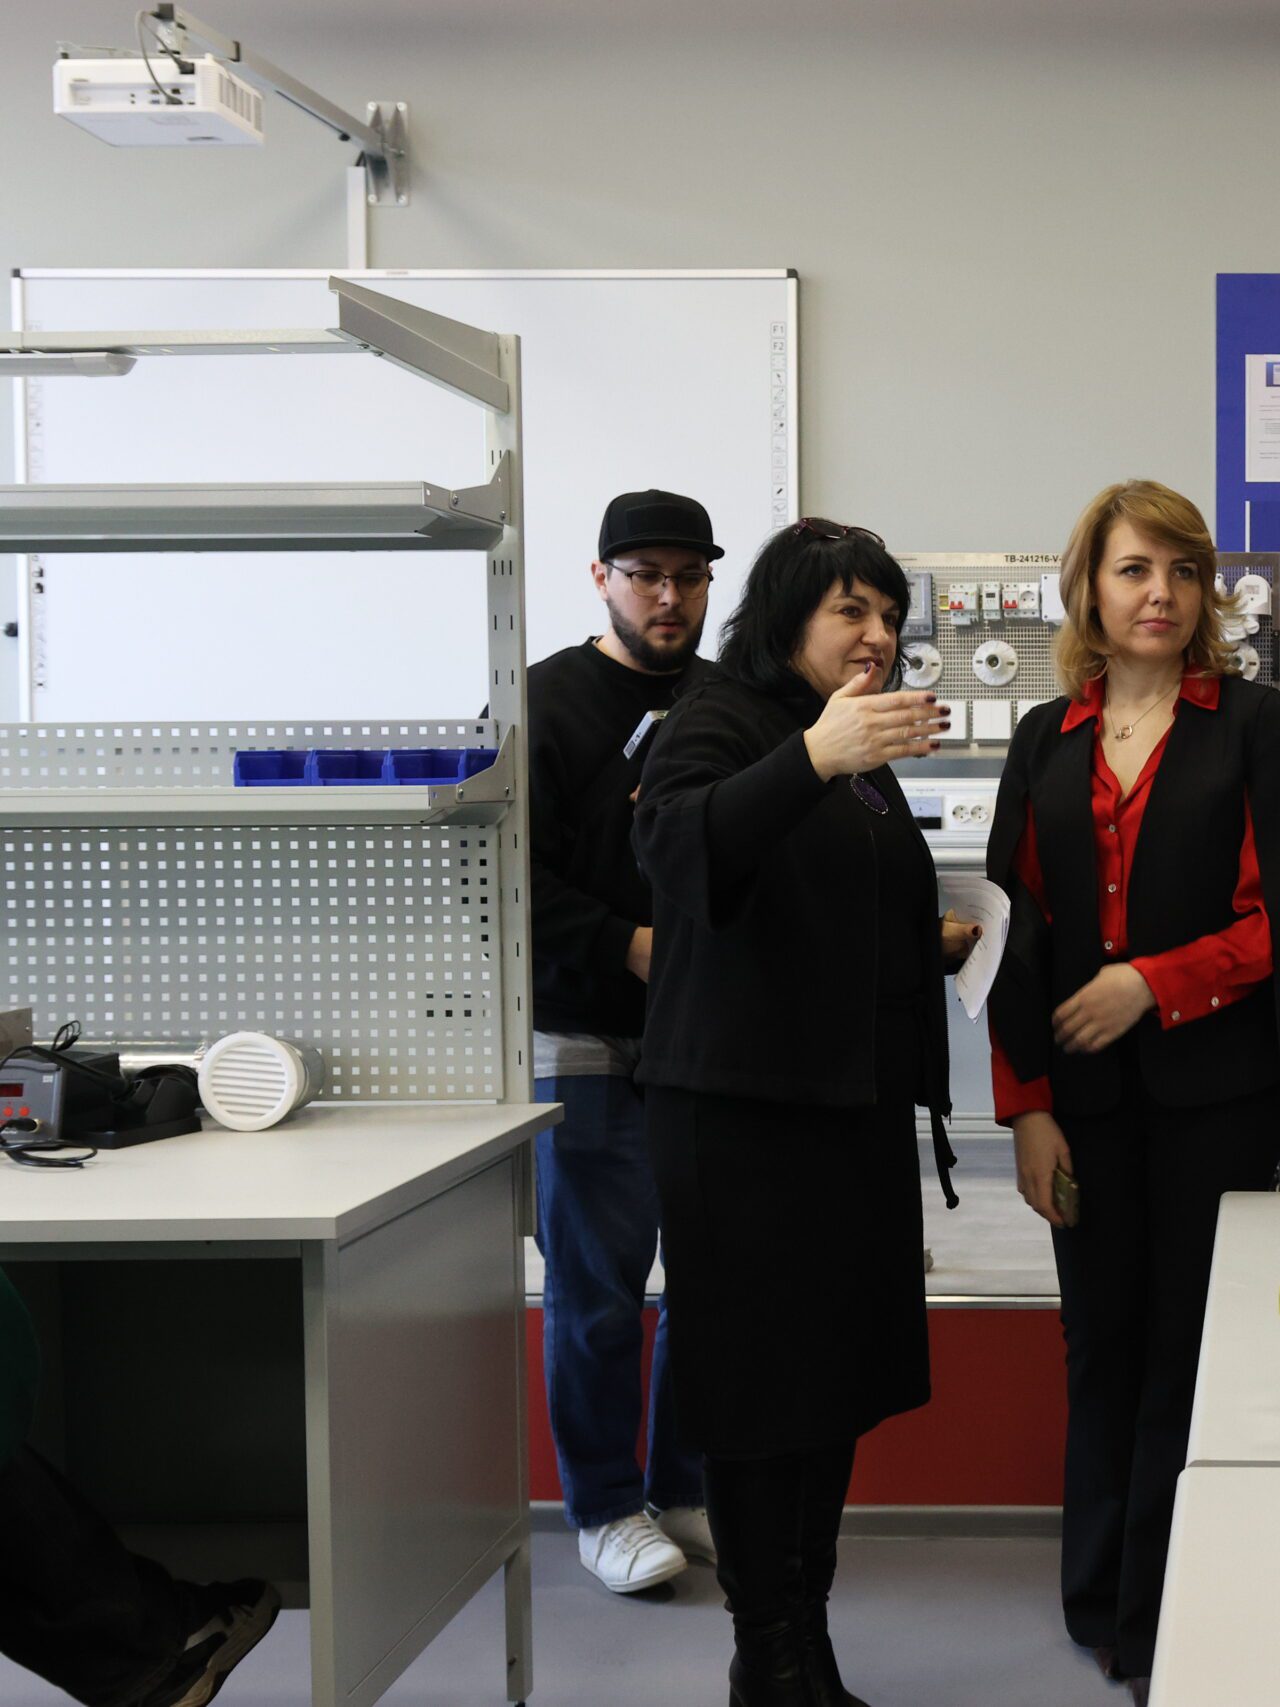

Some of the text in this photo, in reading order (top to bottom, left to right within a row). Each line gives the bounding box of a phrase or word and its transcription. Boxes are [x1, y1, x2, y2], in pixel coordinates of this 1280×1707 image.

[773, 325, 784, 334] F1
[773, 341, 785, 351] F2
[1004, 554, 1061, 563] TB-241216-V-
